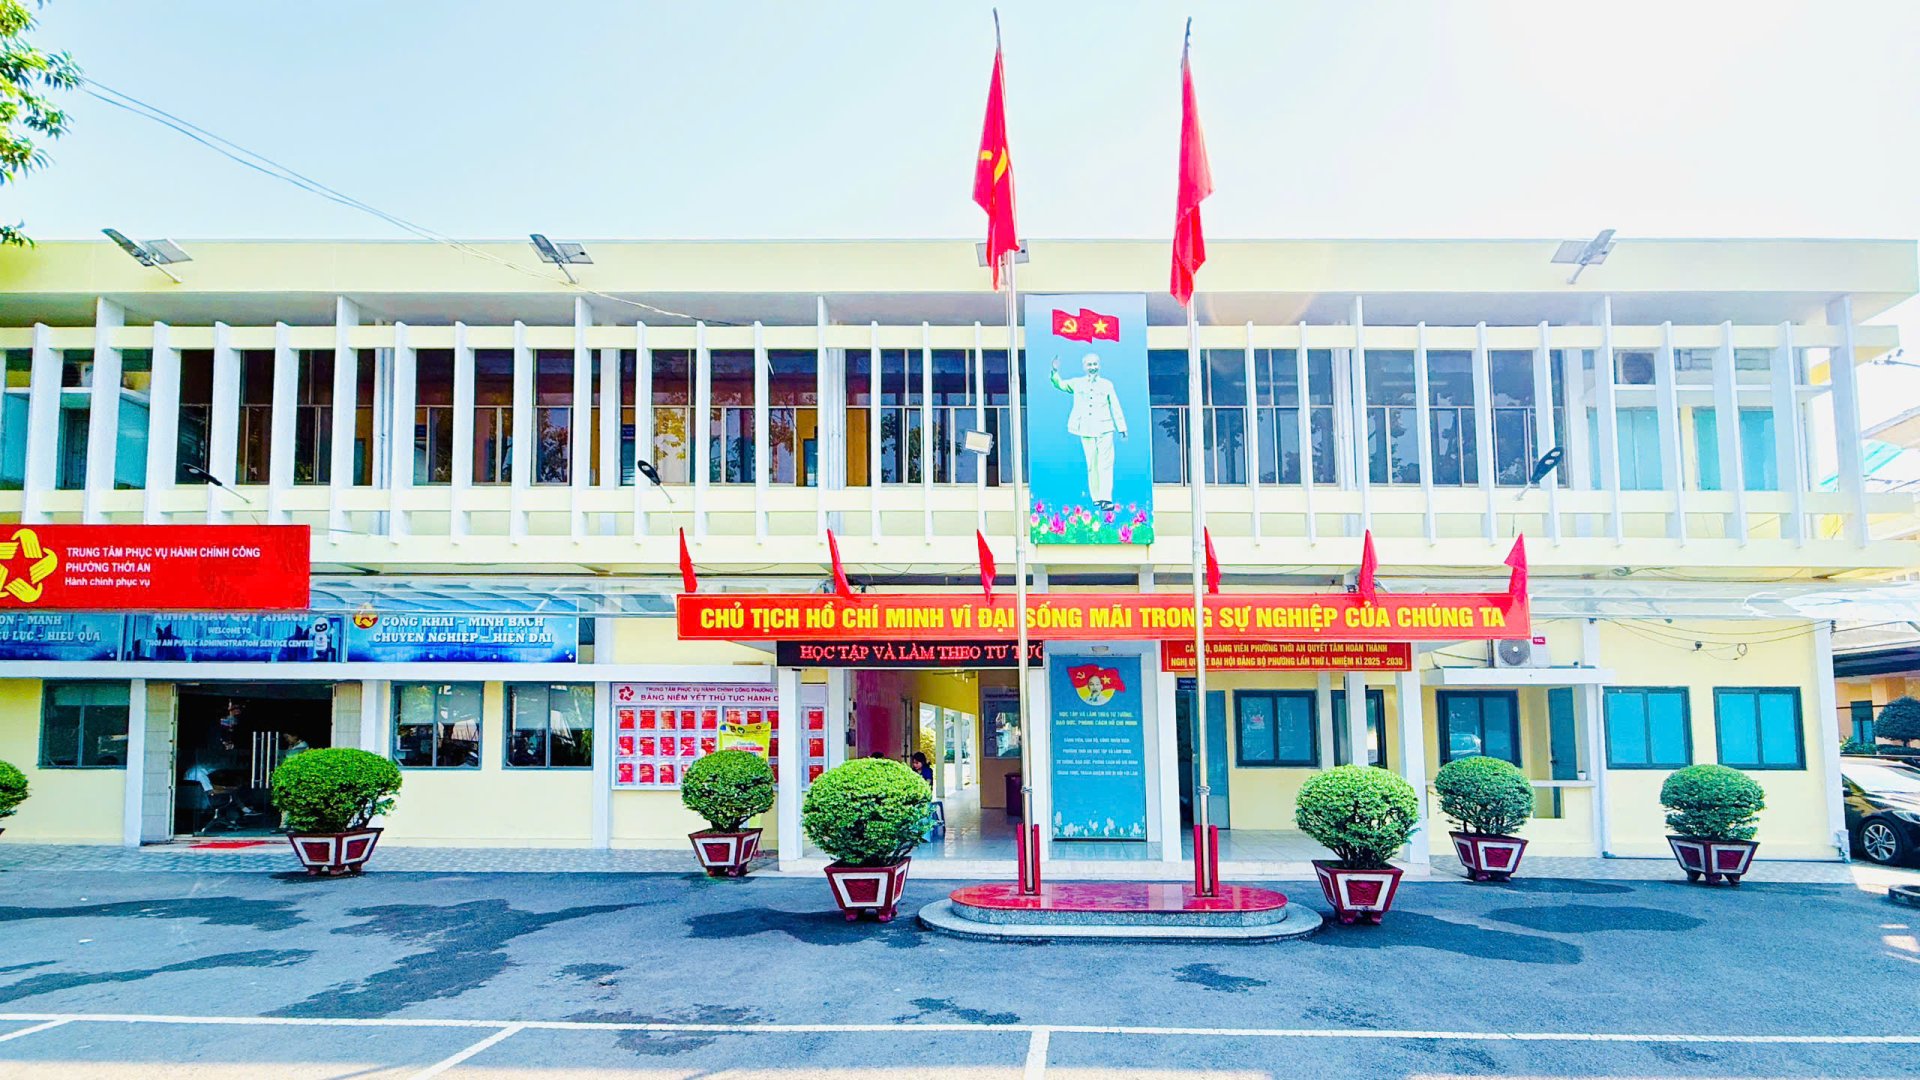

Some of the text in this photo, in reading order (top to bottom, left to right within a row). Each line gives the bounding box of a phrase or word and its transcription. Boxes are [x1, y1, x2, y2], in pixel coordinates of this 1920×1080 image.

[66, 545, 261, 560] TRUNG TÂM PHỤC VỤ HÀNH CHÍNH CÔNG
[66, 560, 110, 572] PHƯỜNG
[137, 562, 150, 572] AN
[65, 577, 151, 588] Hành chính phục vụ
[700, 600, 1506, 633] CHỦ TỊCH HỒ CHÍ MINH VĨ ĐẠI SỐNG MÃI TRONG SỰ NGHIỆP CỦA CHÚNG TA
[422, 617, 454, 627] KHAI
[468, 617, 505, 627] MINH
[508, 617, 545, 629] BẠCH
[174, 640, 198, 648] PUBLIC
[260, 640, 288, 648] SERVICE
[373, 631, 424, 643] CHUYÊN
[428, 631, 479, 645] NGHIỆP
[494, 631, 526, 645] HIỆN
[528, 632, 554, 646] ĐẠI
[800, 646, 835, 662] HỌC
[839, 644, 869, 662] TẬP
[873, 643, 896, 659] VÀ
[899, 643, 936, 660] LÀM
[938, 646, 981, 660] THEO
[984, 644, 1008, 659] TƯ
[1296, 644, 1306, 652] AN
[1364, 657, 1380, 666] 2025
[1386, 657, 1403, 666] 2030
